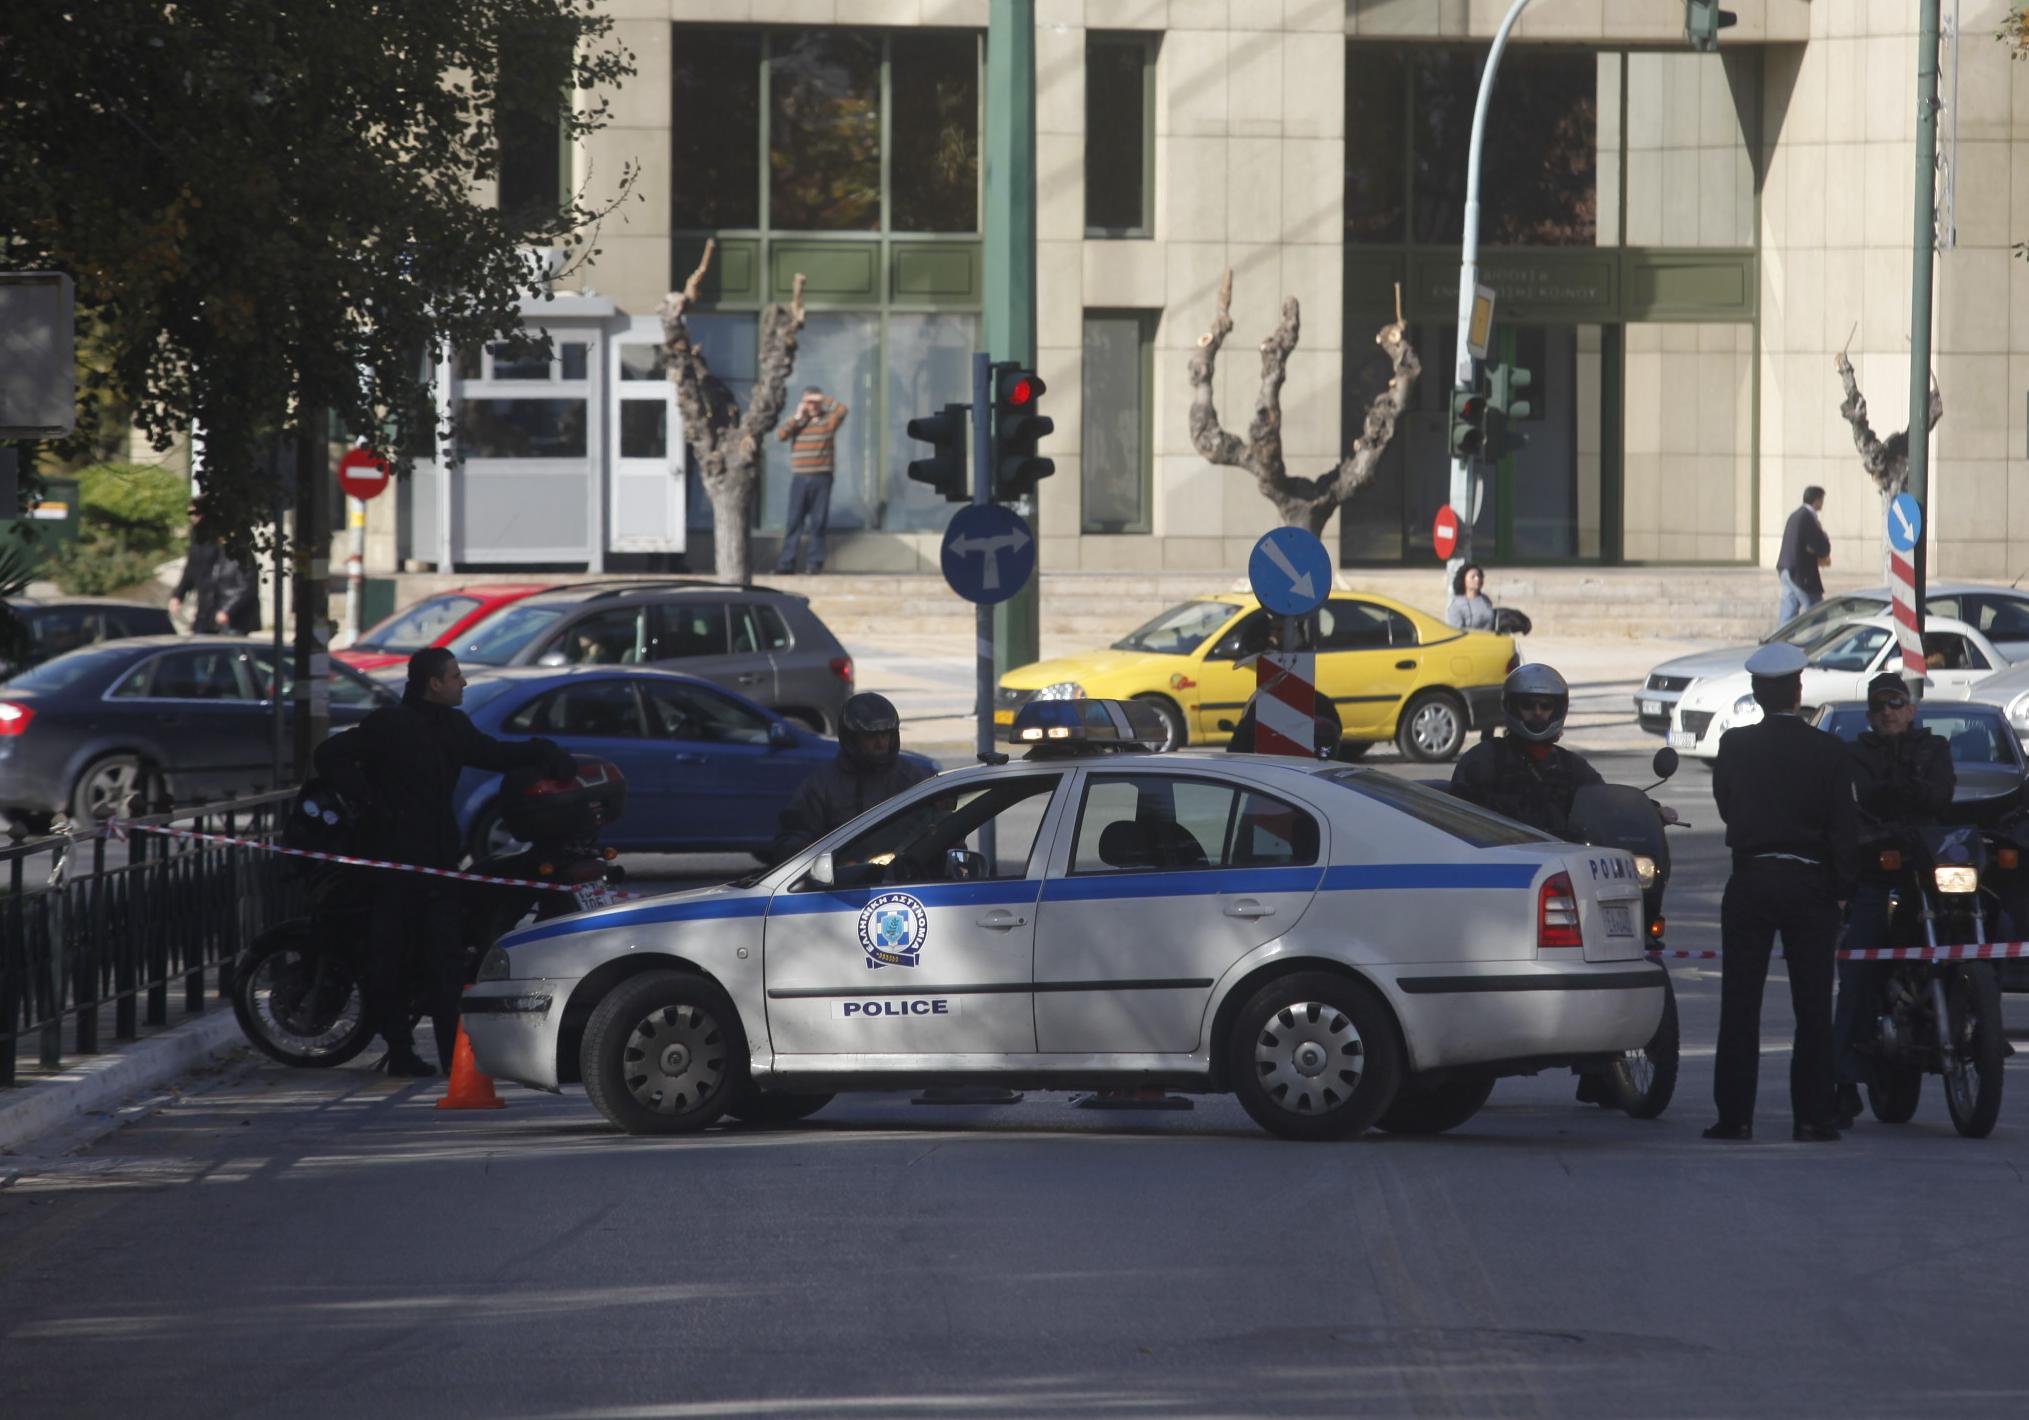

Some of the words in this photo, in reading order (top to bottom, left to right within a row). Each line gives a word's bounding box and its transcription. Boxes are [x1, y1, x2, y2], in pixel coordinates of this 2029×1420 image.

[859, 897, 888, 953] ΕΛΛΗΝΙΚΗ
[891, 895, 926, 949] ΑΣΤΥΝΟΜΙΑ
[843, 999, 949, 1017] POLICE
